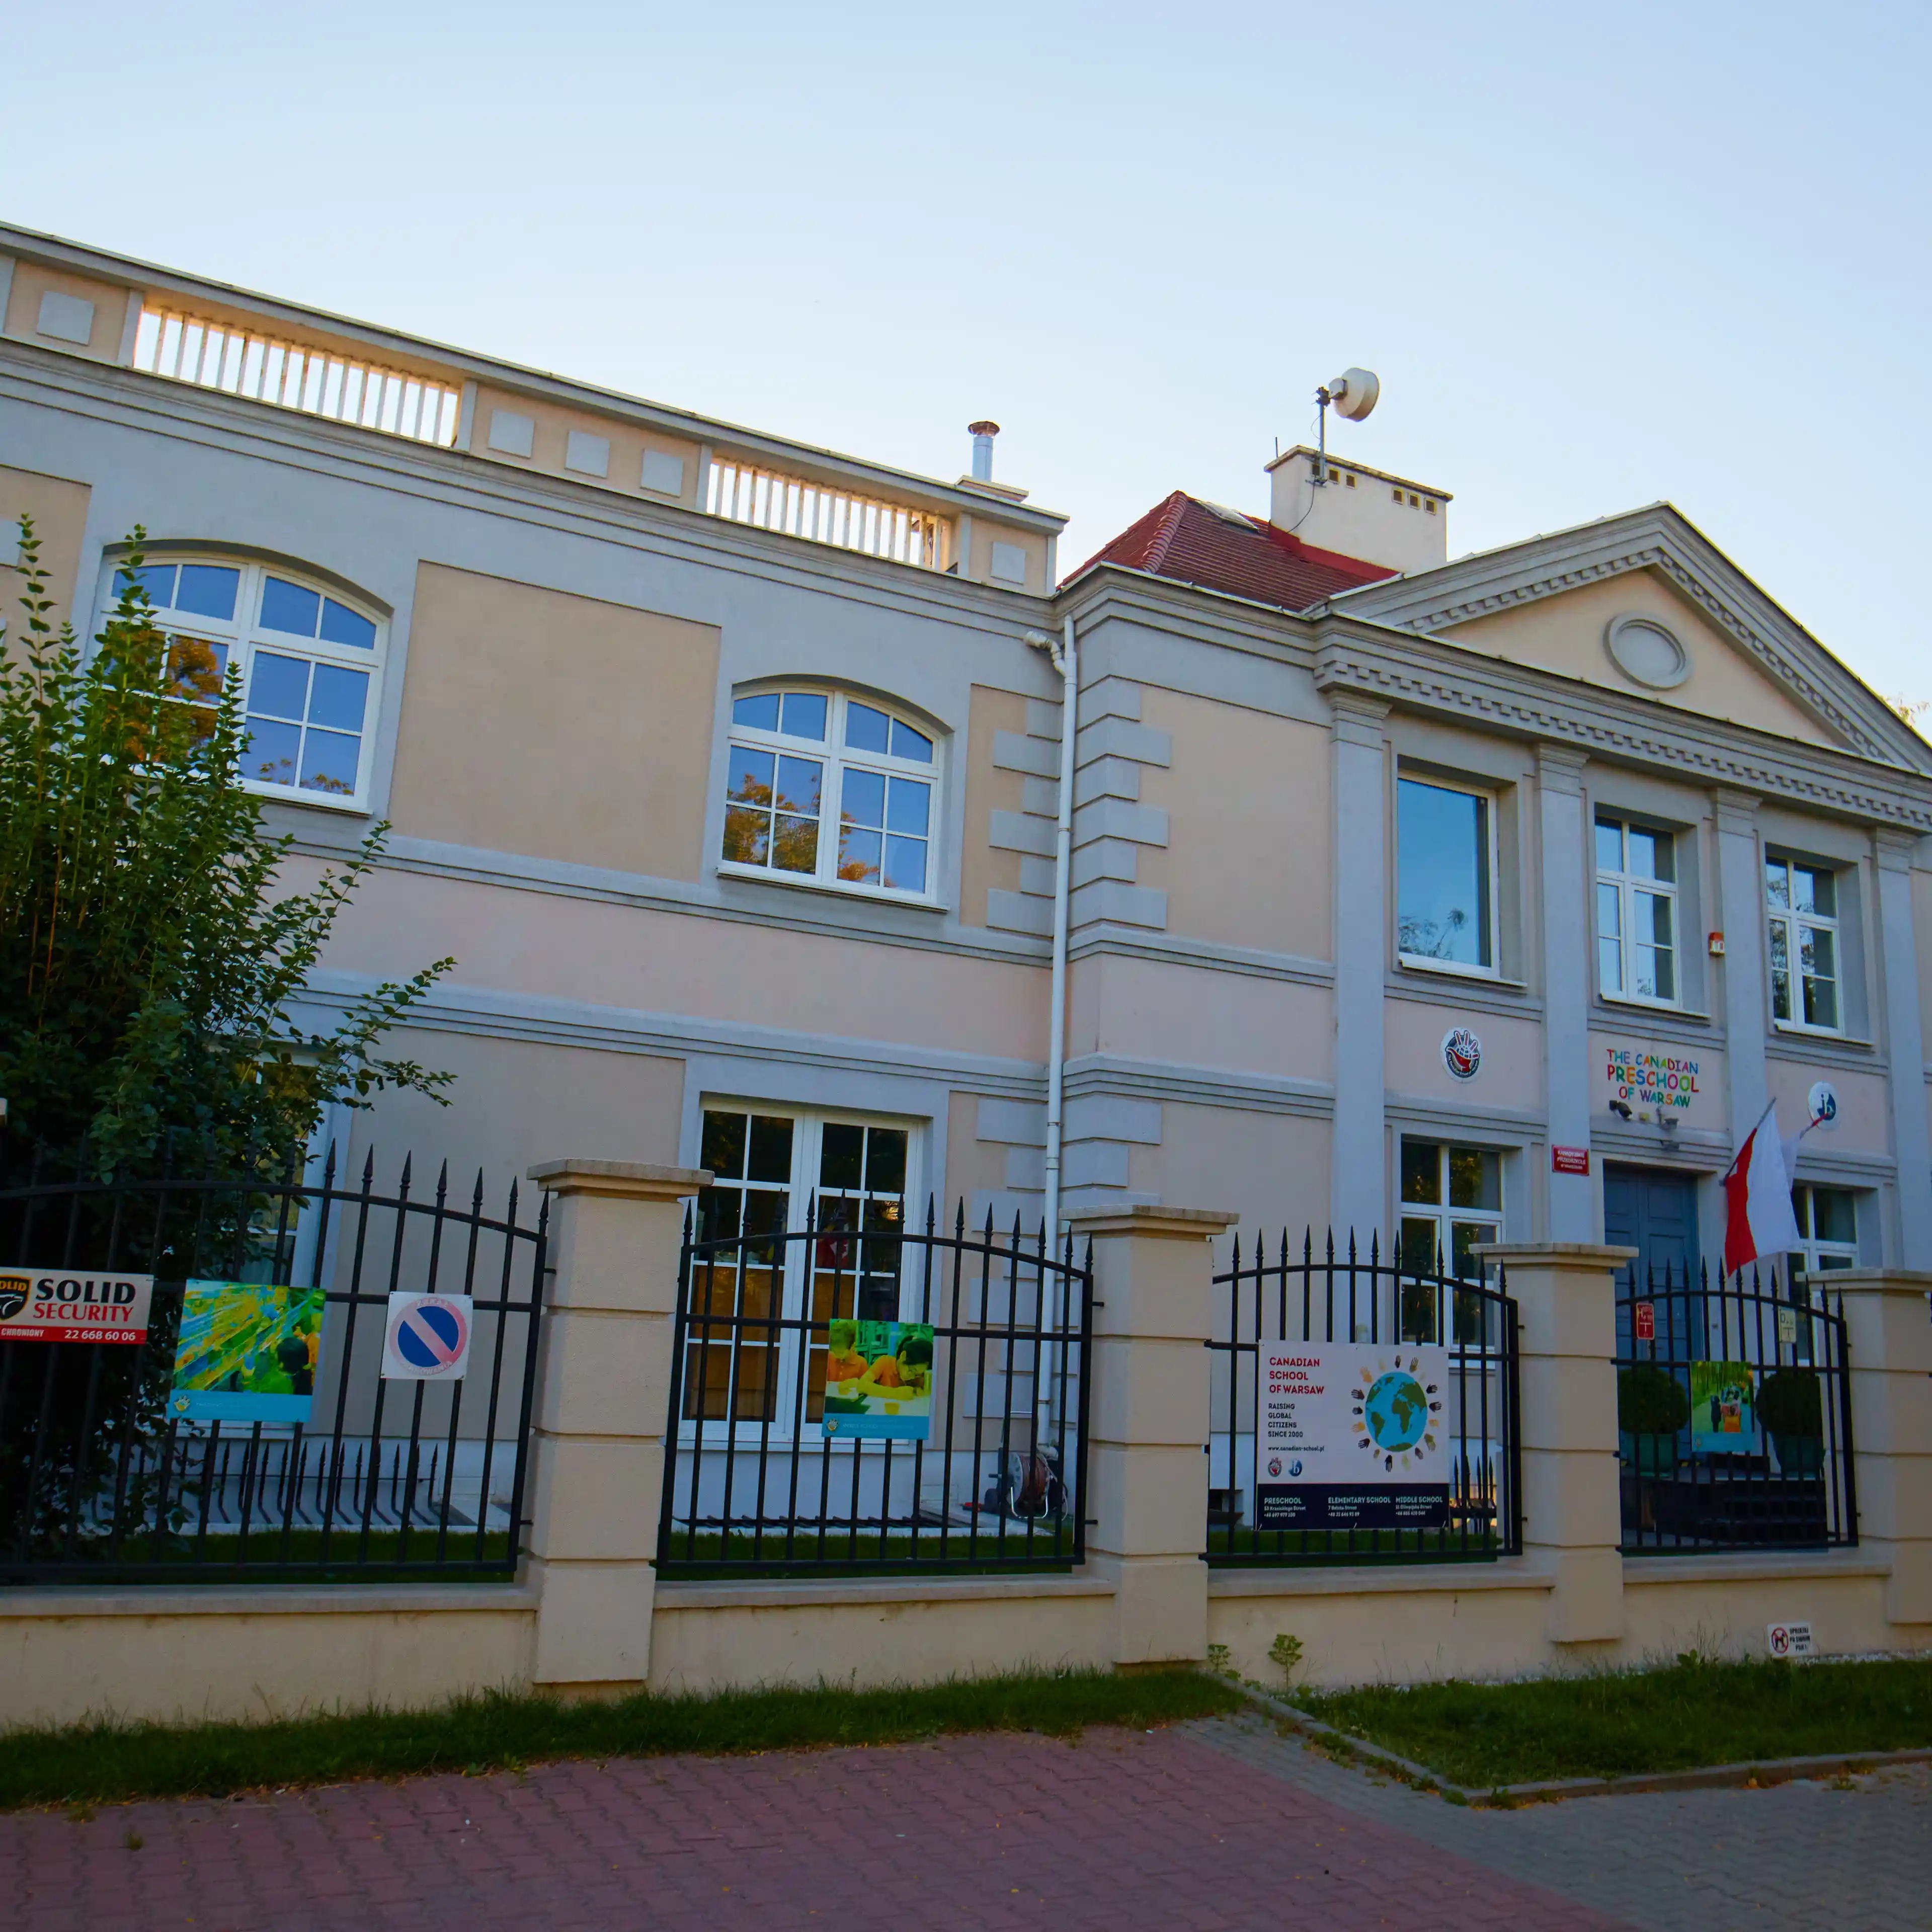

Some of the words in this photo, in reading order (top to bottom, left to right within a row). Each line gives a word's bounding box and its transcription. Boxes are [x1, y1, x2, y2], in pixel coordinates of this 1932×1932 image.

[1606, 1049, 1630, 1065] THE
[1636, 1054, 1698, 1074] CANADIAN
[1607, 1064, 1699, 1092] PRESCHOOL
[1619, 1086, 1635, 1099] OF
[1640, 1089, 1691, 1108] WARSAW
[36, 1278, 136, 1304] SOLID
[33, 1303, 133, 1322] SECURITY
[64, 1330, 78, 1339] 22
[82, 1331, 103, 1339] 668
[105, 1331, 119, 1340] 60
[122, 1332, 136, 1341] 06
[1269, 1357, 1320, 1366] CANADIAN
[1269, 1371, 1308, 1381] SCHOOL
[1269, 1385, 1281, 1393] OF
[1283, 1385, 1324, 1394] WARSAW
